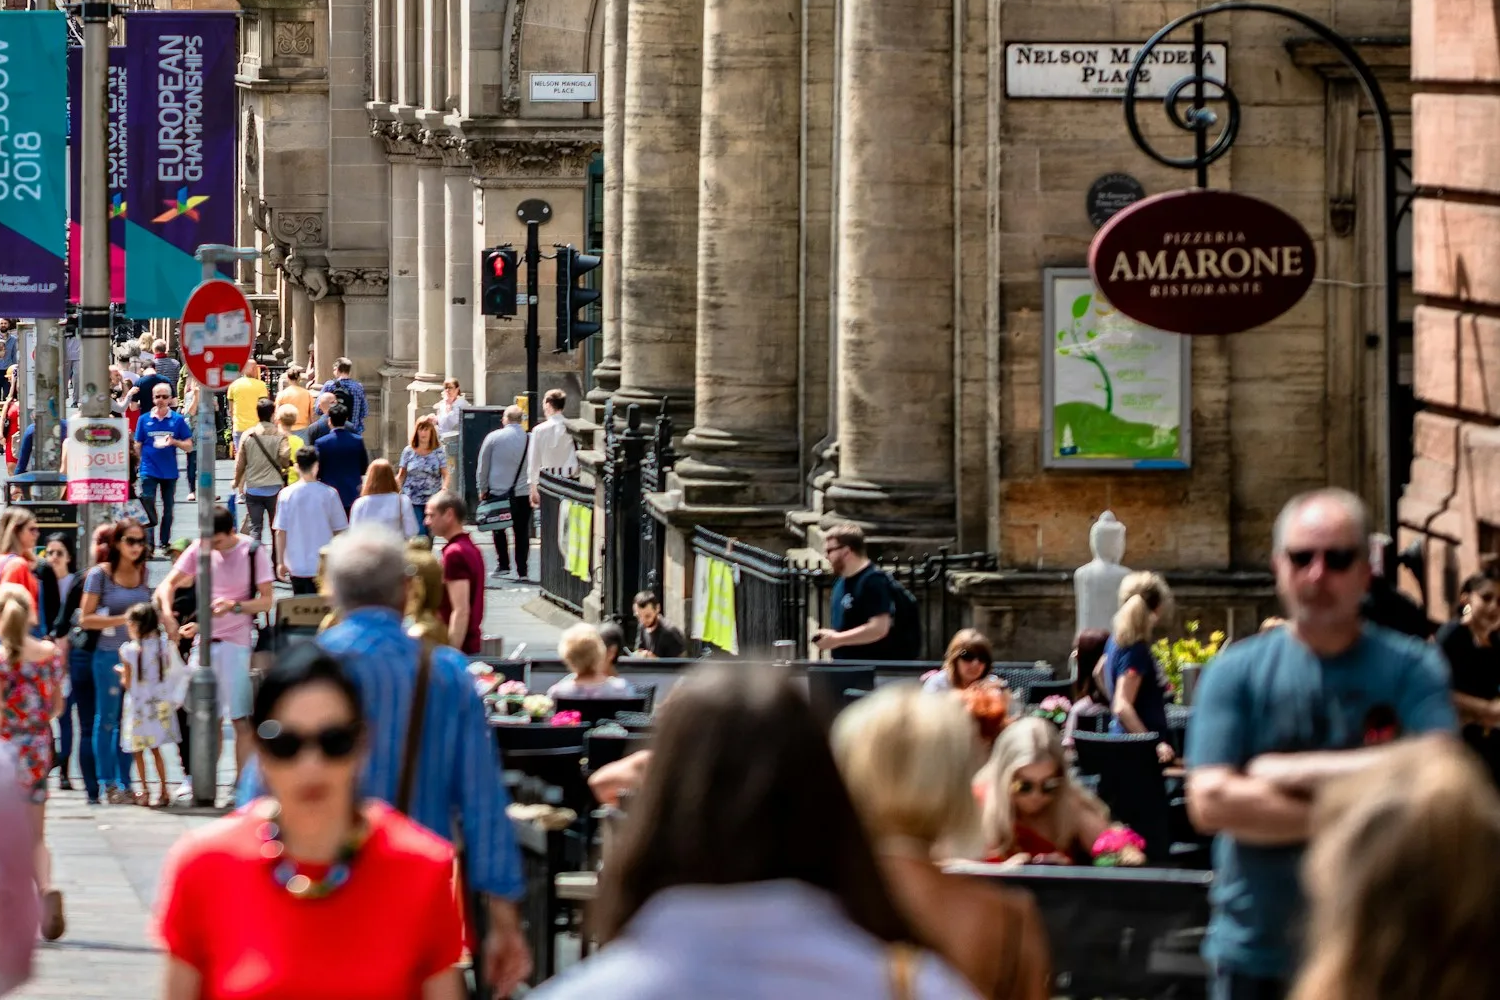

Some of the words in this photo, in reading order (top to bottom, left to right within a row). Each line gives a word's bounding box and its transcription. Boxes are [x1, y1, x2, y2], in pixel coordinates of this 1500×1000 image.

[1016, 48, 1098, 64] NELSON
[158, 35, 184, 181] EUROPEAN
[184, 35, 203, 181] CHAMPIONSHIPS
[13, 132, 41, 201] 2018
[1163, 231, 1246, 245] PIZZERIA
[1109, 246, 1303, 282] AMARONE
[38, 283, 58, 293] LLP
[1150, 282, 1263, 298] RISTORANTE
